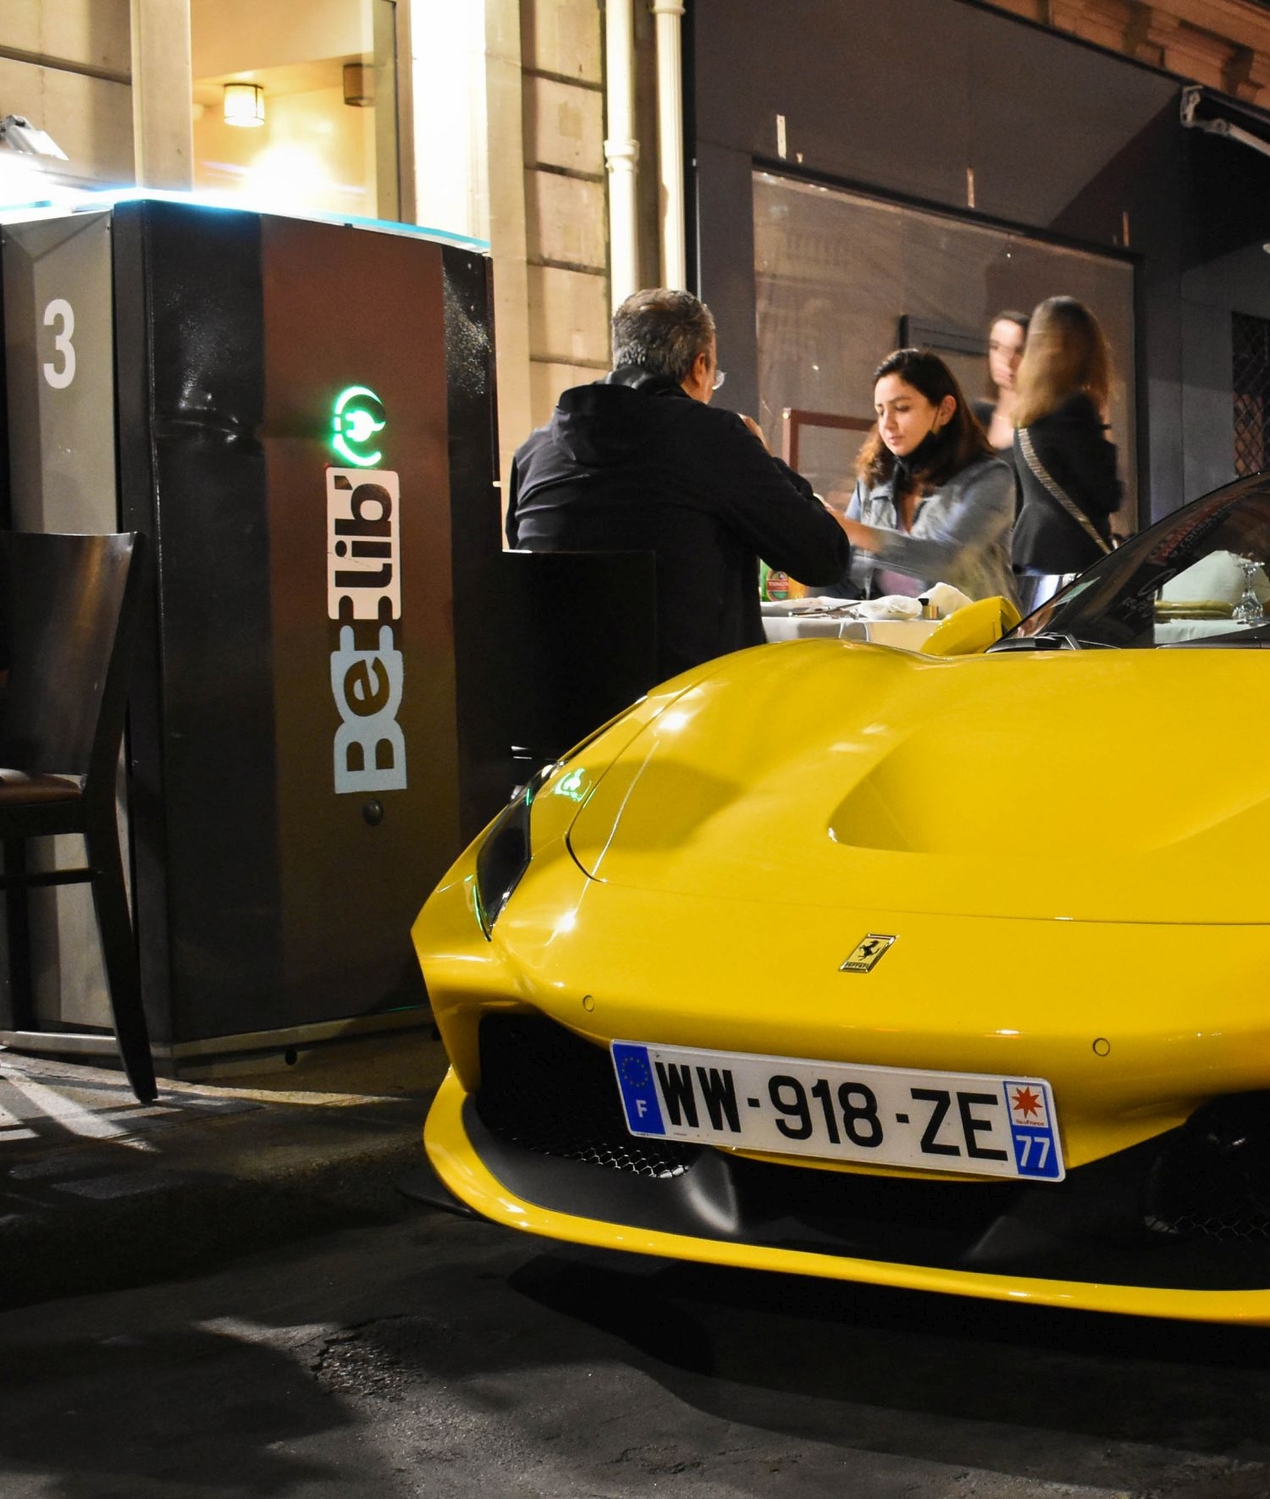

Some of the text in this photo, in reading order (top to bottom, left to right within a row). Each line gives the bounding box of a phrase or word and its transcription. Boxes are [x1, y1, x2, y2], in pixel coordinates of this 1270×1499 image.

[44, 298, 76, 389] 3
[636, 1099, 647, 1118] F
[655, 1061, 1009, 1162] WW-918-ZE
[1016, 1135, 1050, 1168] 77
